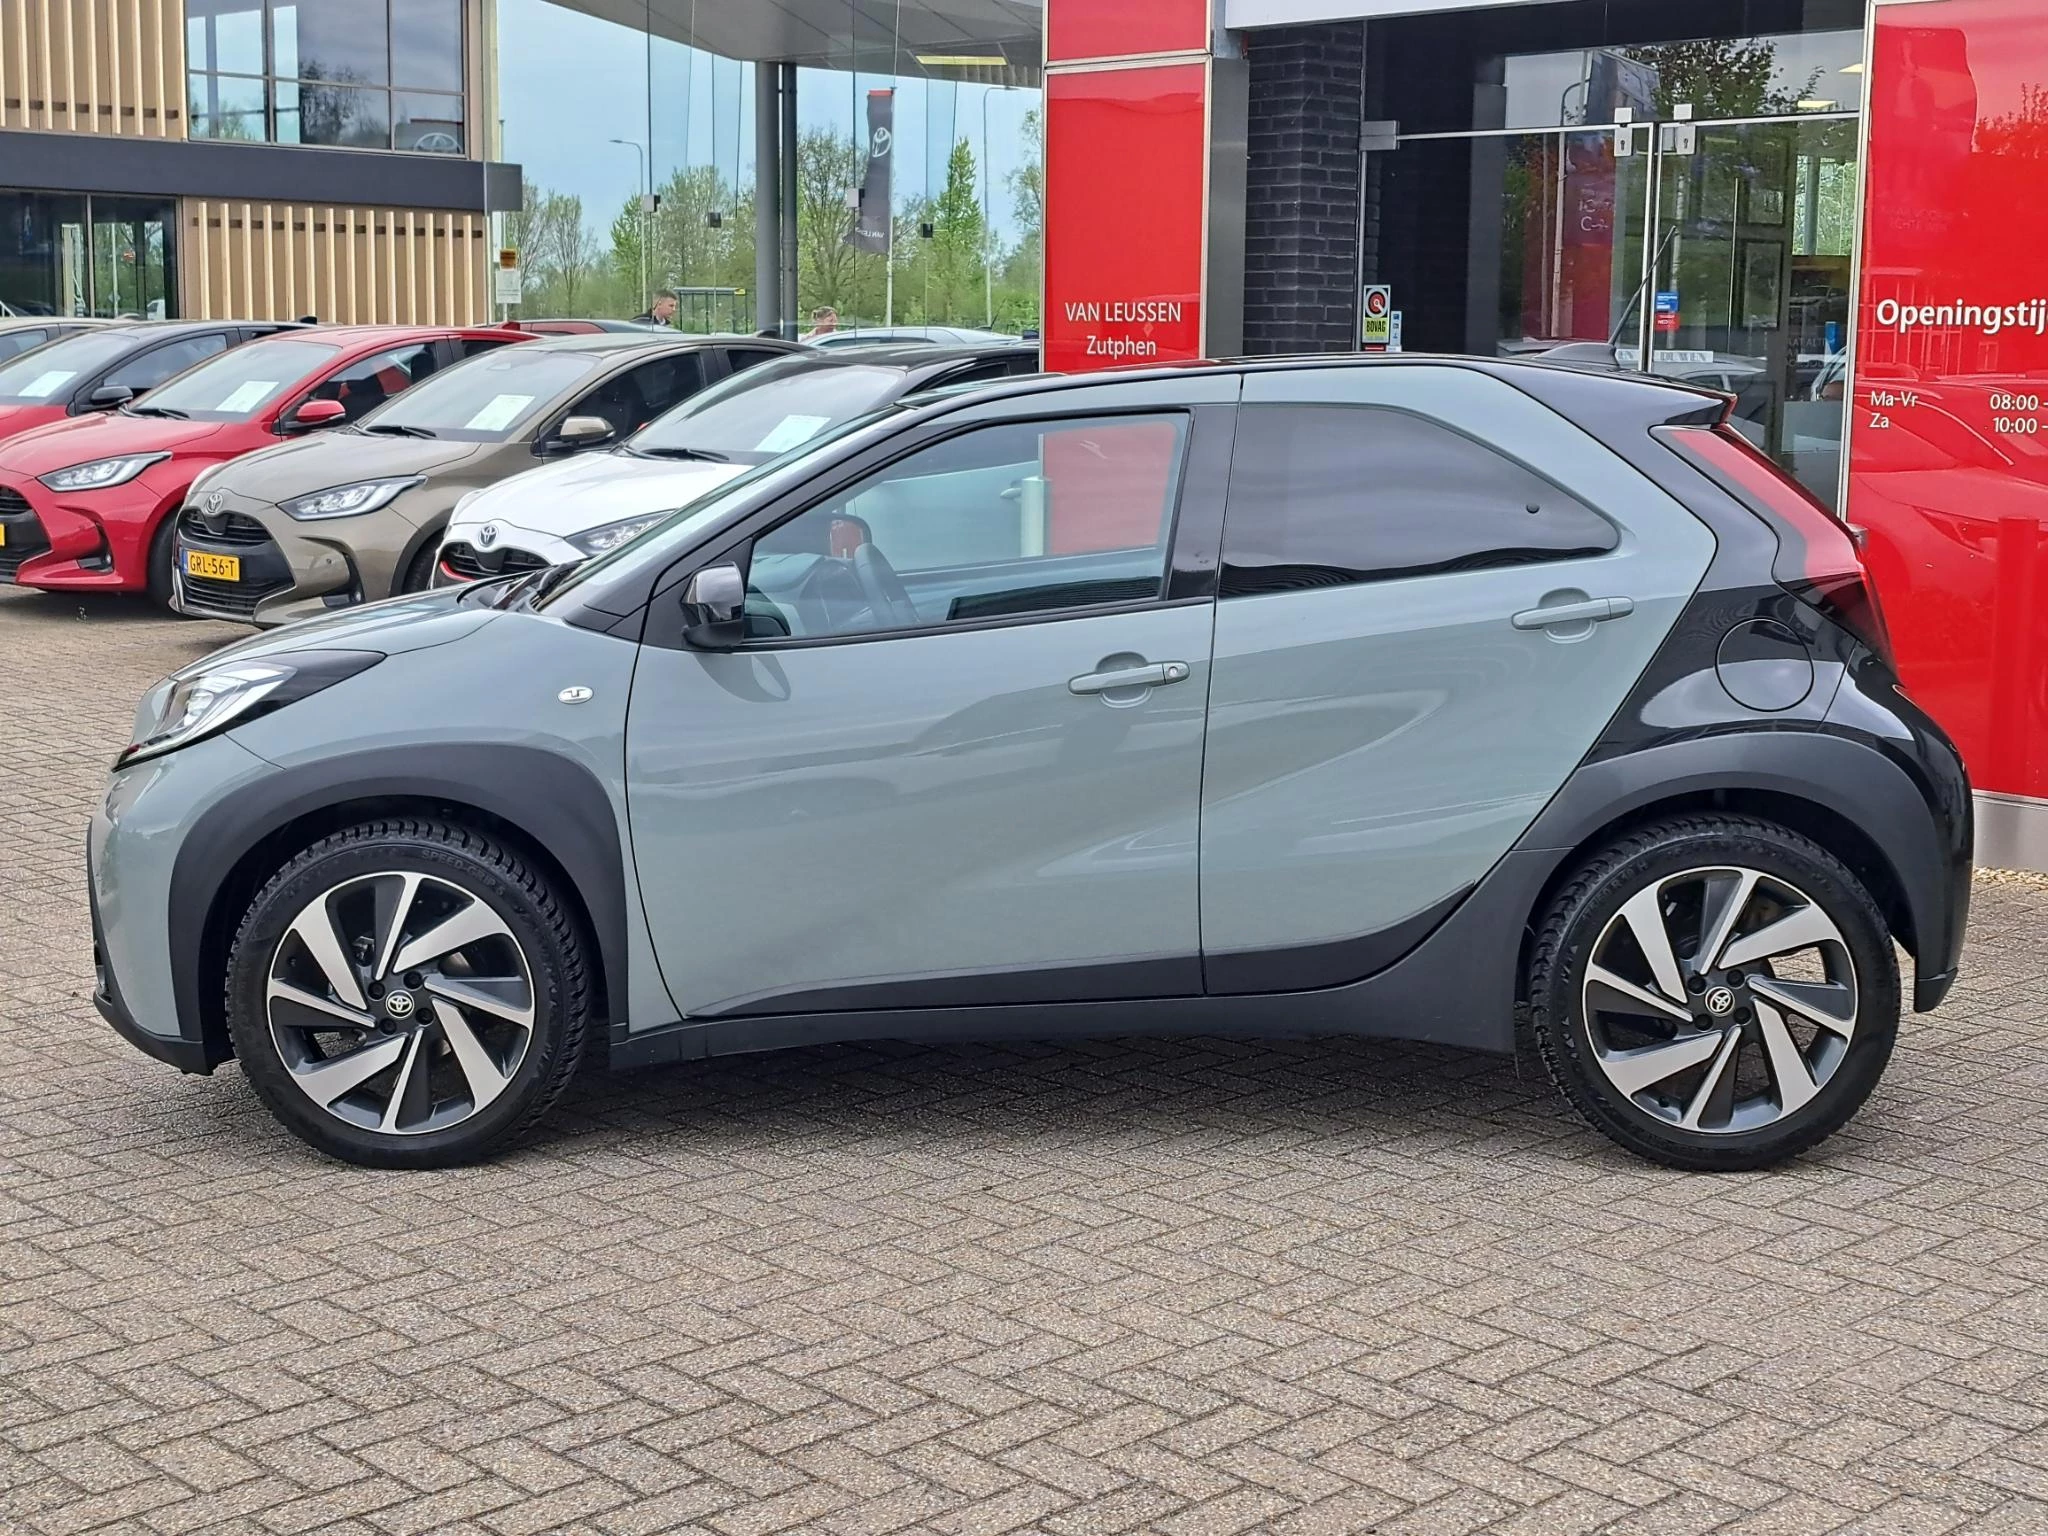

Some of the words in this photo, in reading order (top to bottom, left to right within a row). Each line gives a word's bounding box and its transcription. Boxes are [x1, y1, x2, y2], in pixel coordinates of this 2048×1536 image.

[1065, 302, 1100, 322] VAN
[1105, 302, 1181, 322] LEUSSEN
[1876, 298, 2048, 335] Openingstij
[1366, 320, 1386, 333] BOVAG
[1087, 334, 1157, 360] Zutphen
[1870, 391, 1919, 407] Ma-Vr
[1990, 393, 2039, 411] 08:00
[1869, 412, 1890, 428] Za
[1993, 417, 2038, 434] 10:00
[190, 554, 235, 577] GRL-56-T
